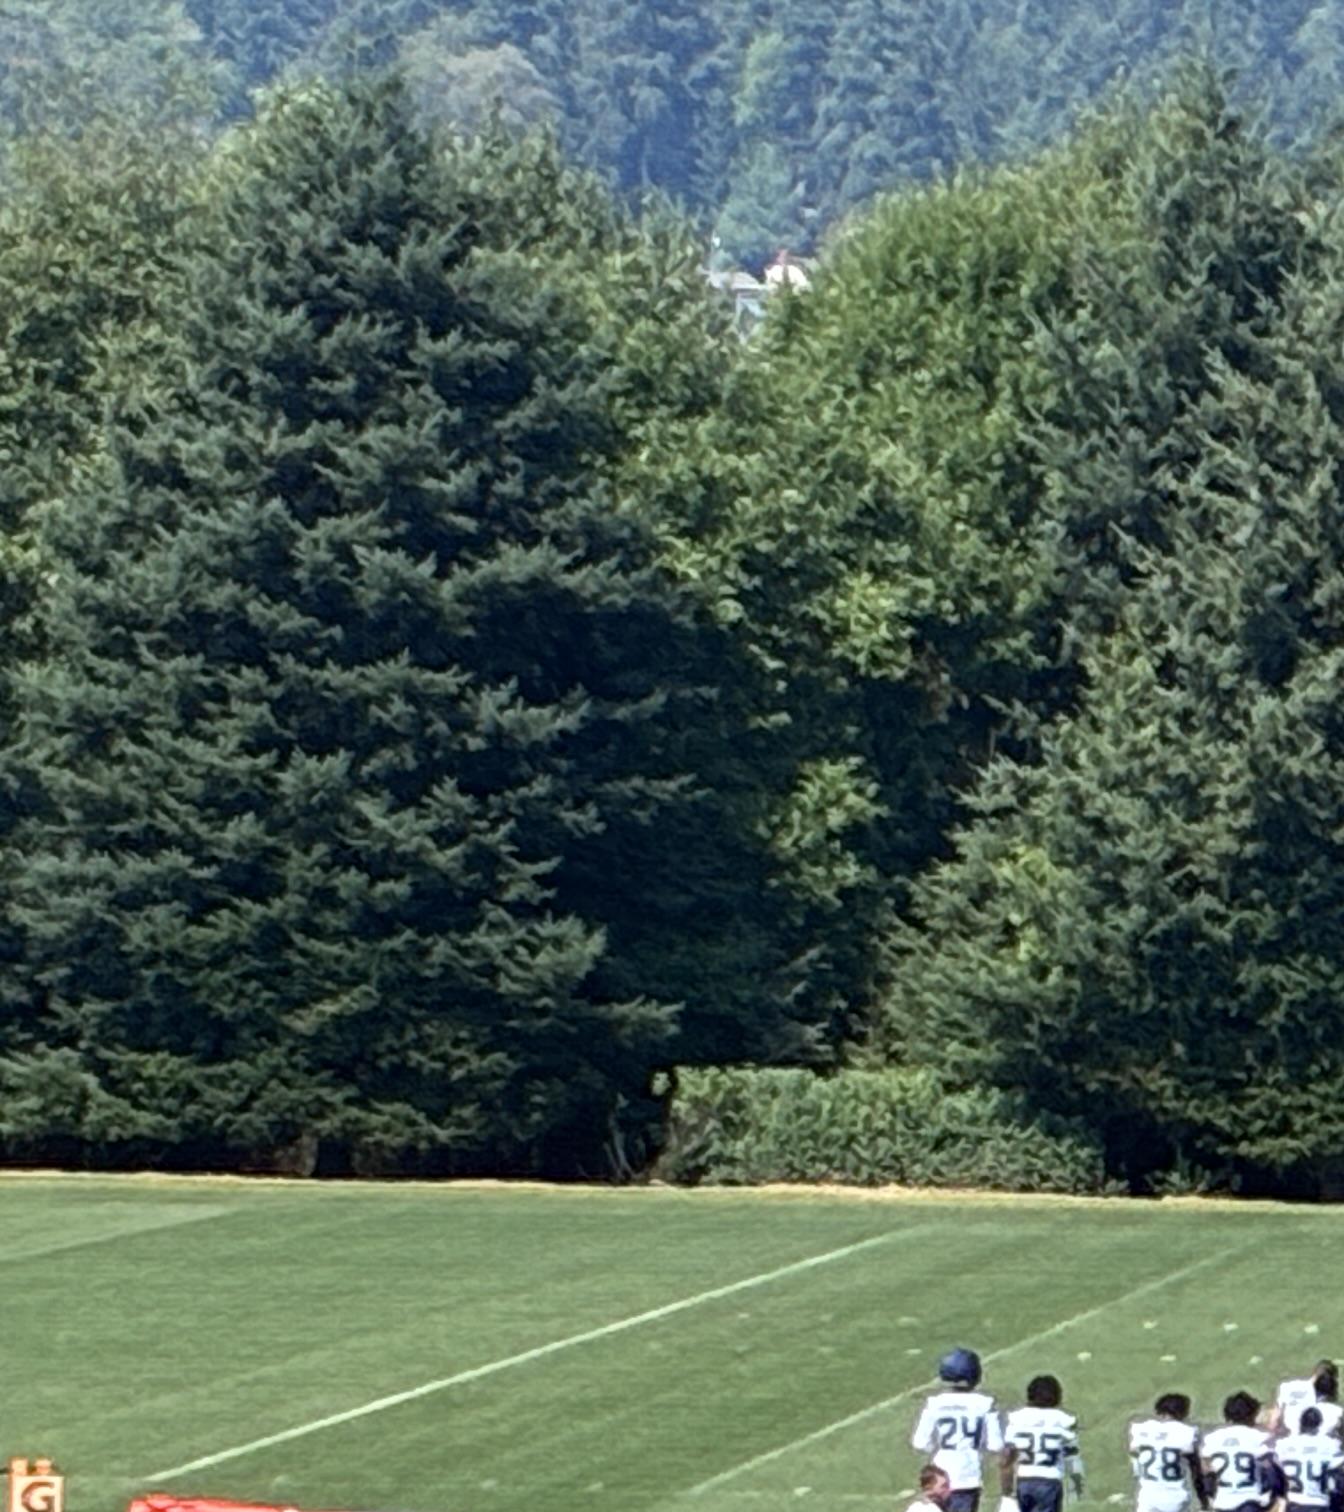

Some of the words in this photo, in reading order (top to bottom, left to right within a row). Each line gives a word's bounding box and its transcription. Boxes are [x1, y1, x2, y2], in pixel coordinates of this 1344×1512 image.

[936, 1416, 983, 1450] 24
[1138, 1445, 1183, 1481] 28
[1210, 1452, 1257, 1488] 29
